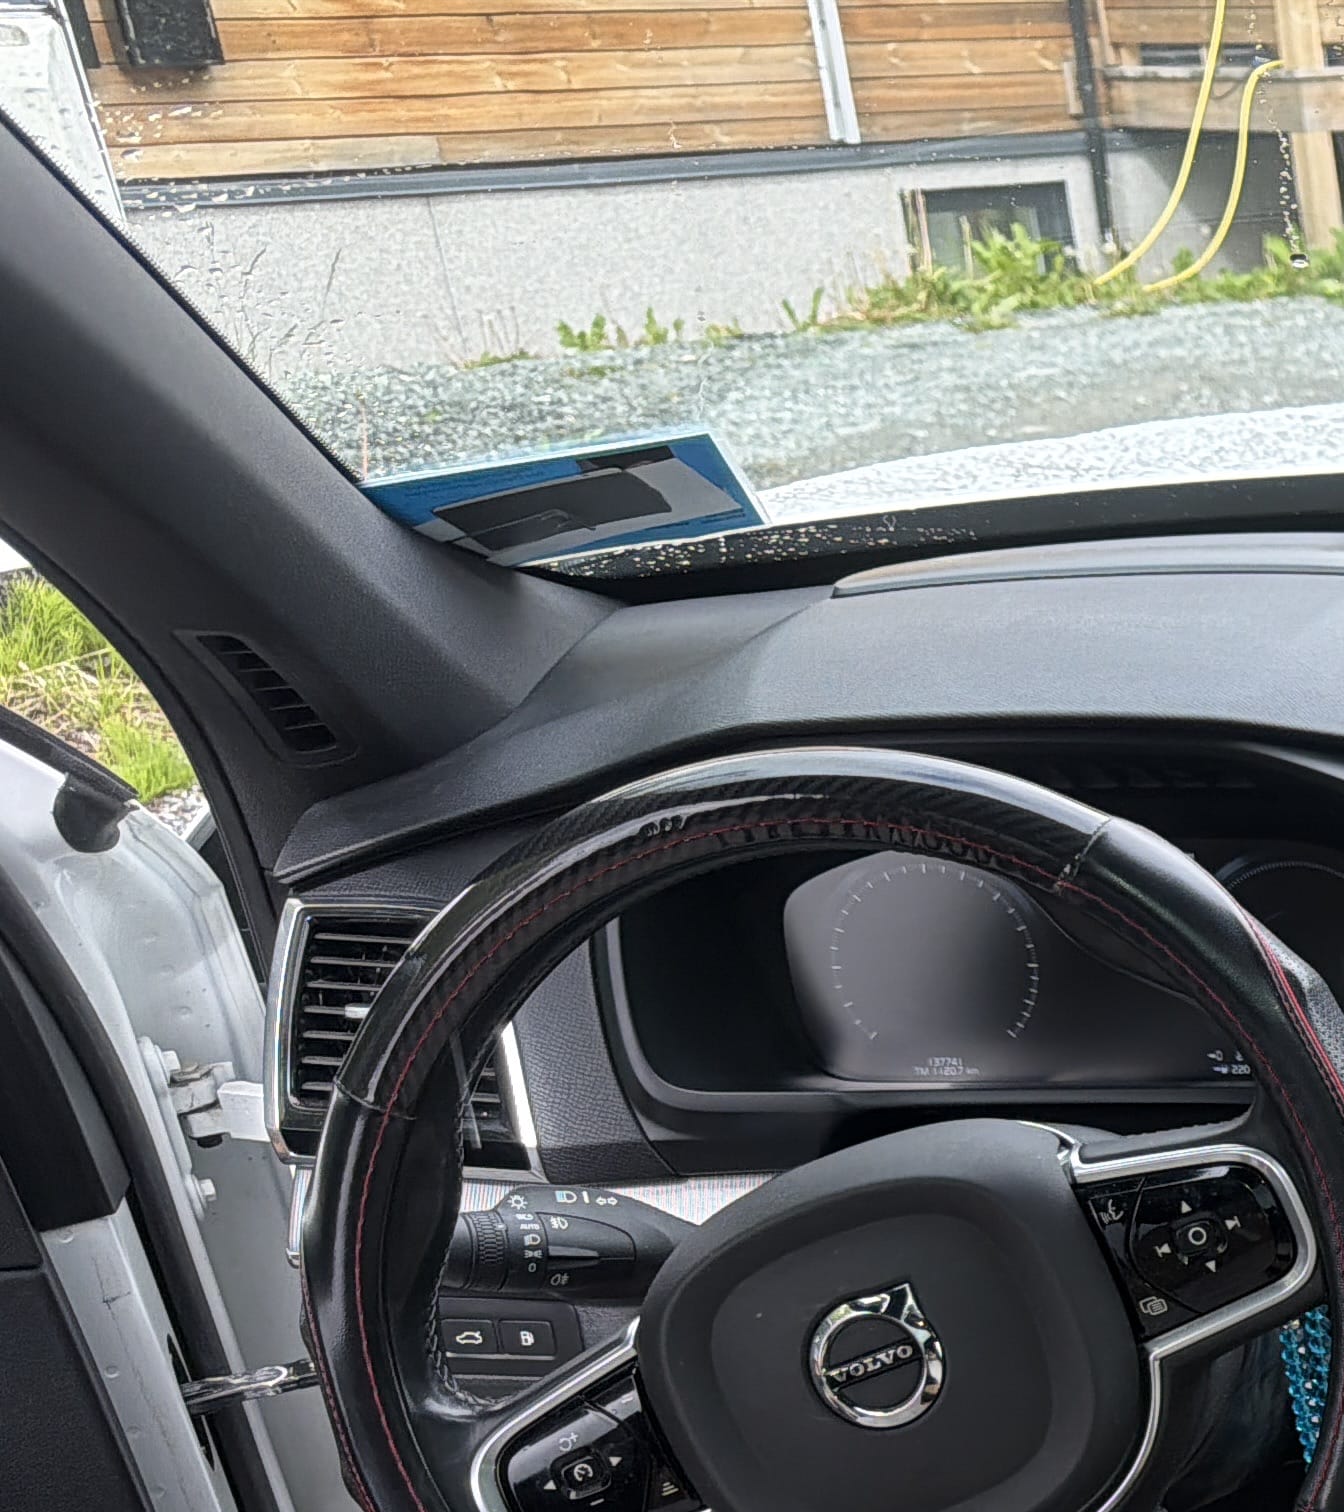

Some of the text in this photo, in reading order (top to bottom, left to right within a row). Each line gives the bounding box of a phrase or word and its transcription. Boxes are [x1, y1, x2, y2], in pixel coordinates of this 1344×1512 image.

[1231, 1063, 1251, 1075] 220
[520, 1223, 541, 1231] AUTO
[827, 1345, 914, 1382] VOLVO
